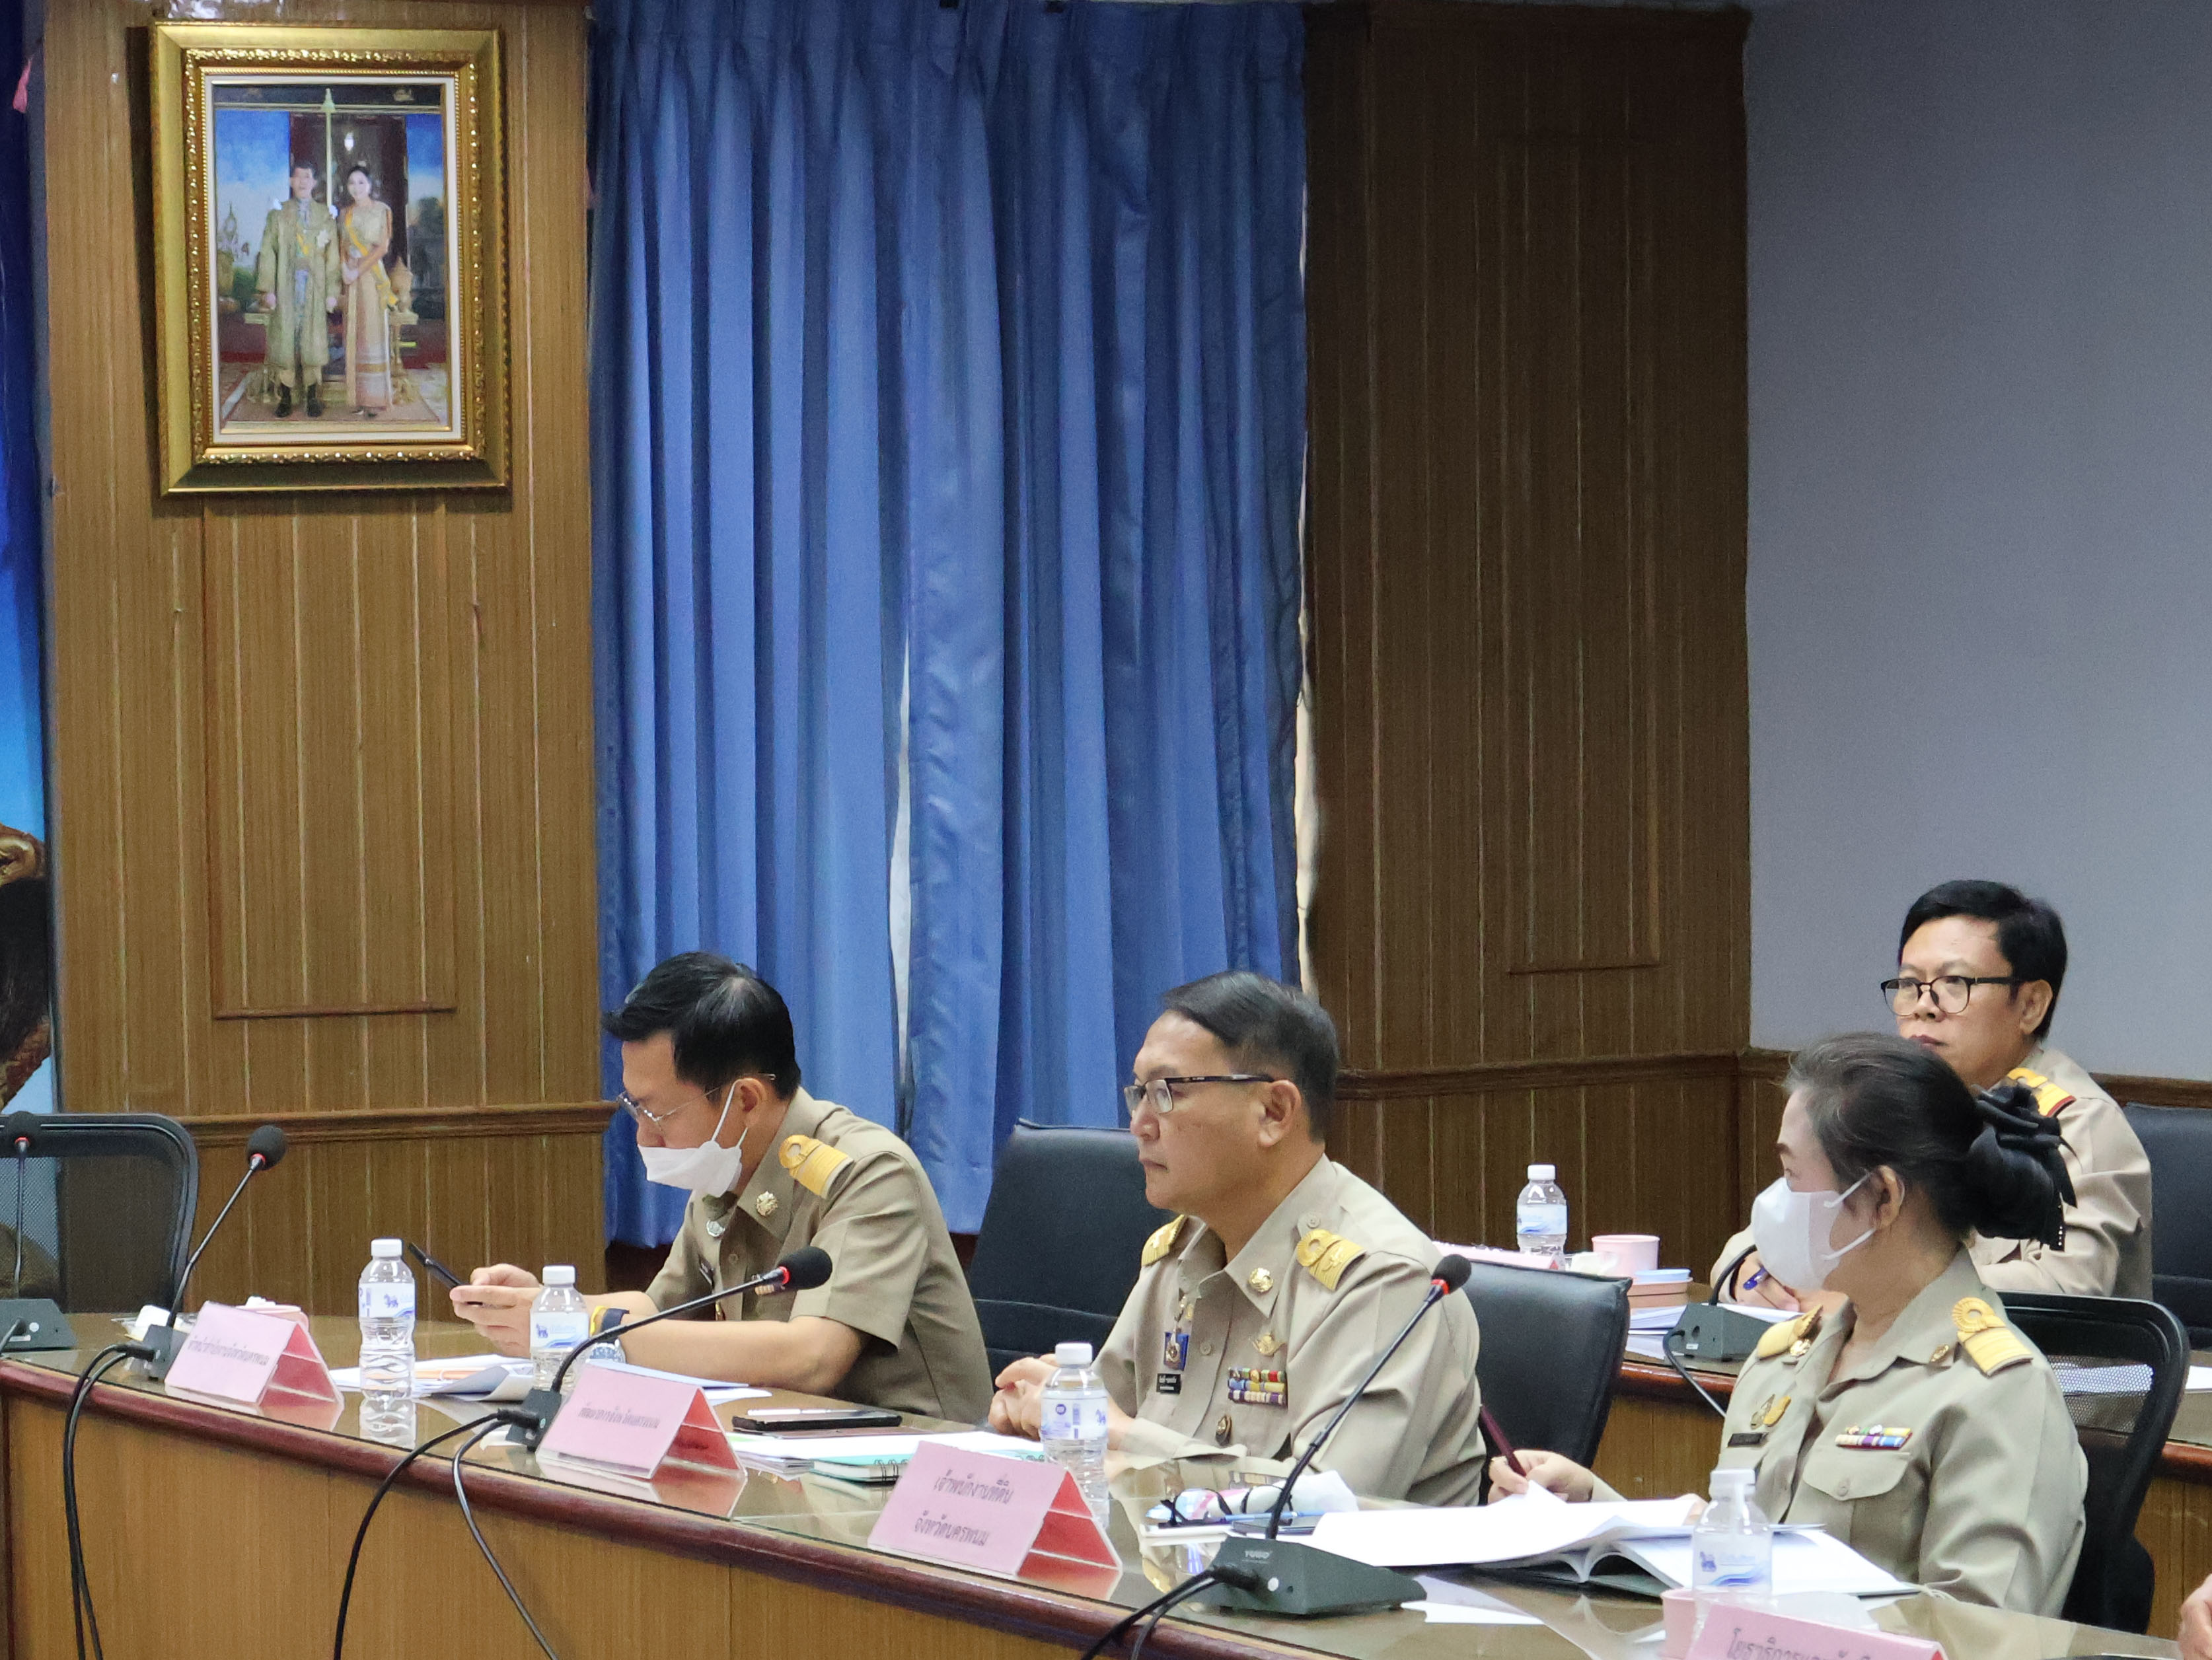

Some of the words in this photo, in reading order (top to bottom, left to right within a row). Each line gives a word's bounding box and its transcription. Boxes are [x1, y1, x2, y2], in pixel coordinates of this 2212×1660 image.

[914, 1510, 990, 1546] จังหวัดนครพนม
